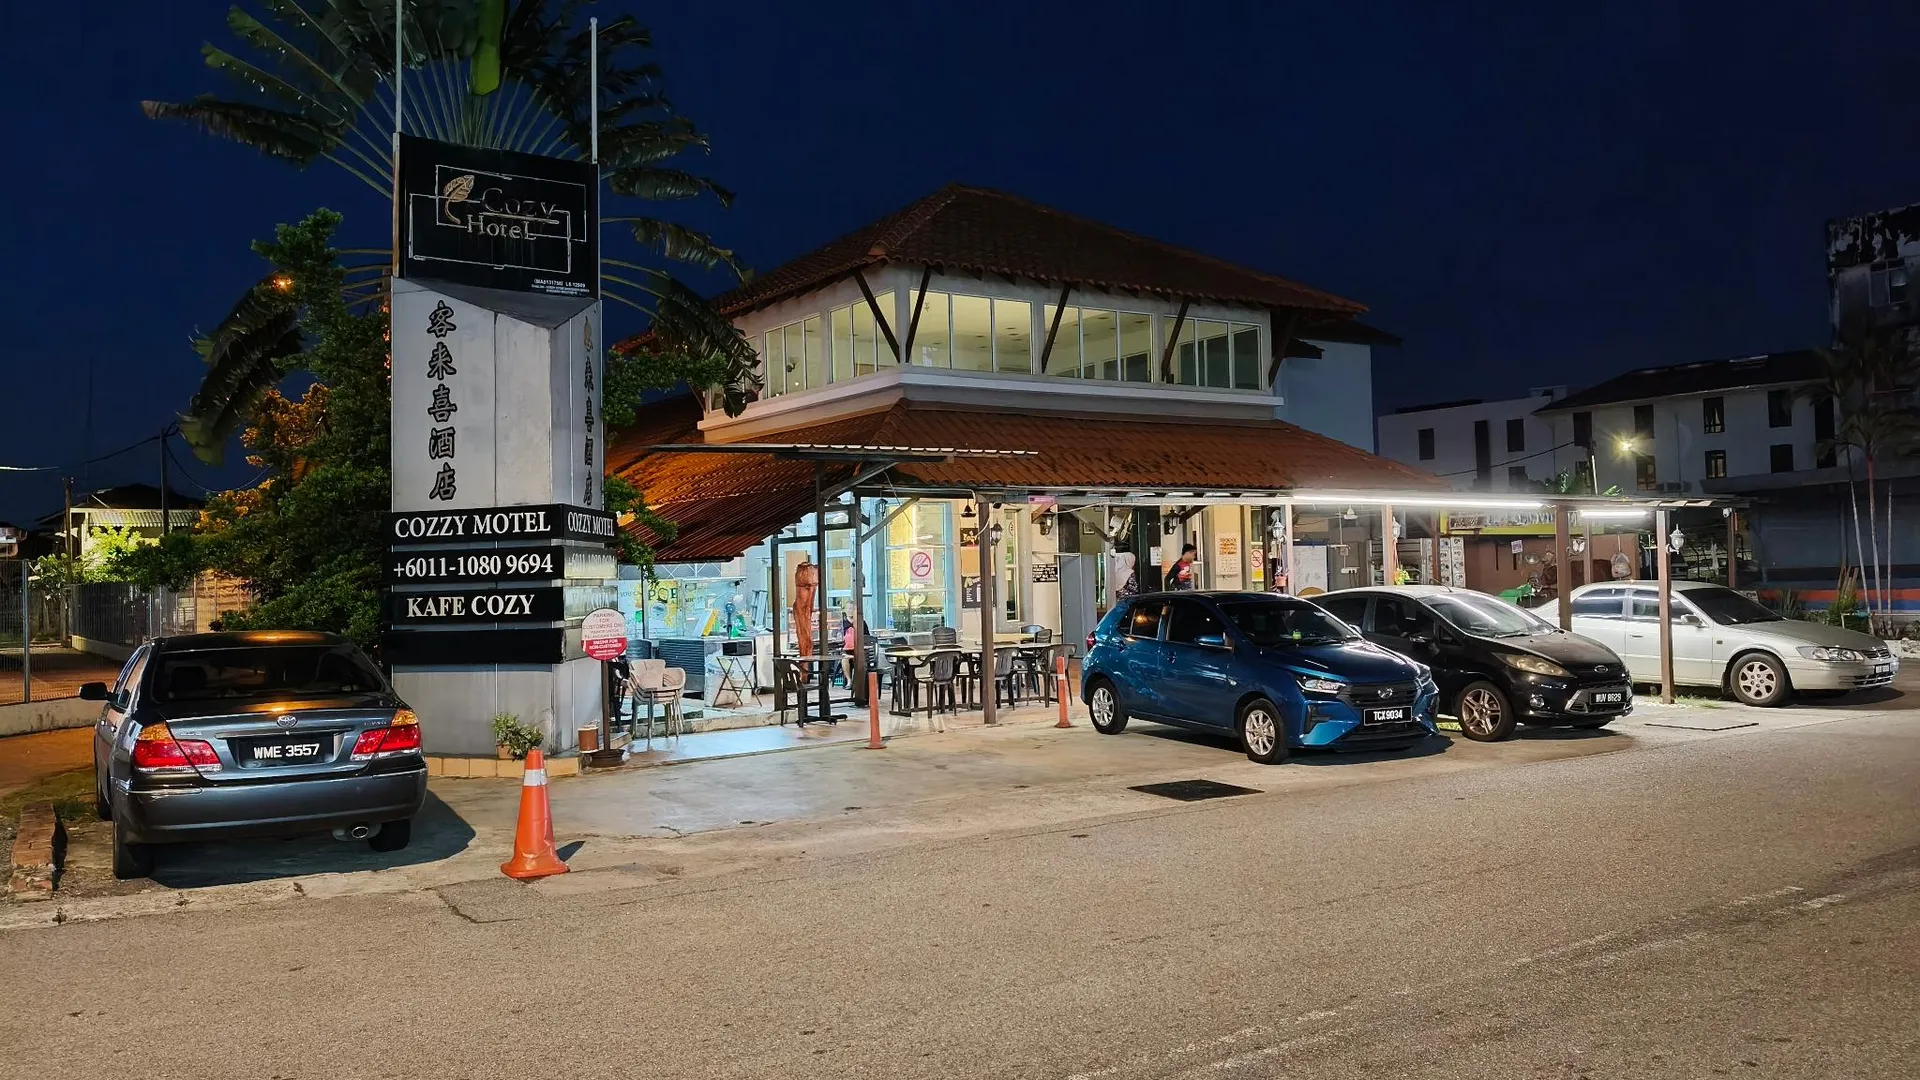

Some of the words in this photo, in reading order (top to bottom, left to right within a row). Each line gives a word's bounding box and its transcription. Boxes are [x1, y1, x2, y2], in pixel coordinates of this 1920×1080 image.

[427, 299, 457, 501] 客来喜酒店
[395, 515, 467, 538] COZZY
[472, 511, 551, 535] MOTEL
[567, 511, 592, 534] COZZY
[591, 515, 615, 537] MOTEL
[393, 555, 501, 578] +6011-1080
[505, 553, 554, 575] 9694
[406, 596, 466, 618] KAFE
[470, 594, 535, 616] COZY
[1373, 709, 1403, 721] TCX9034
[254, 746, 281, 759] WME
[285, 744, 320, 757] 3557
